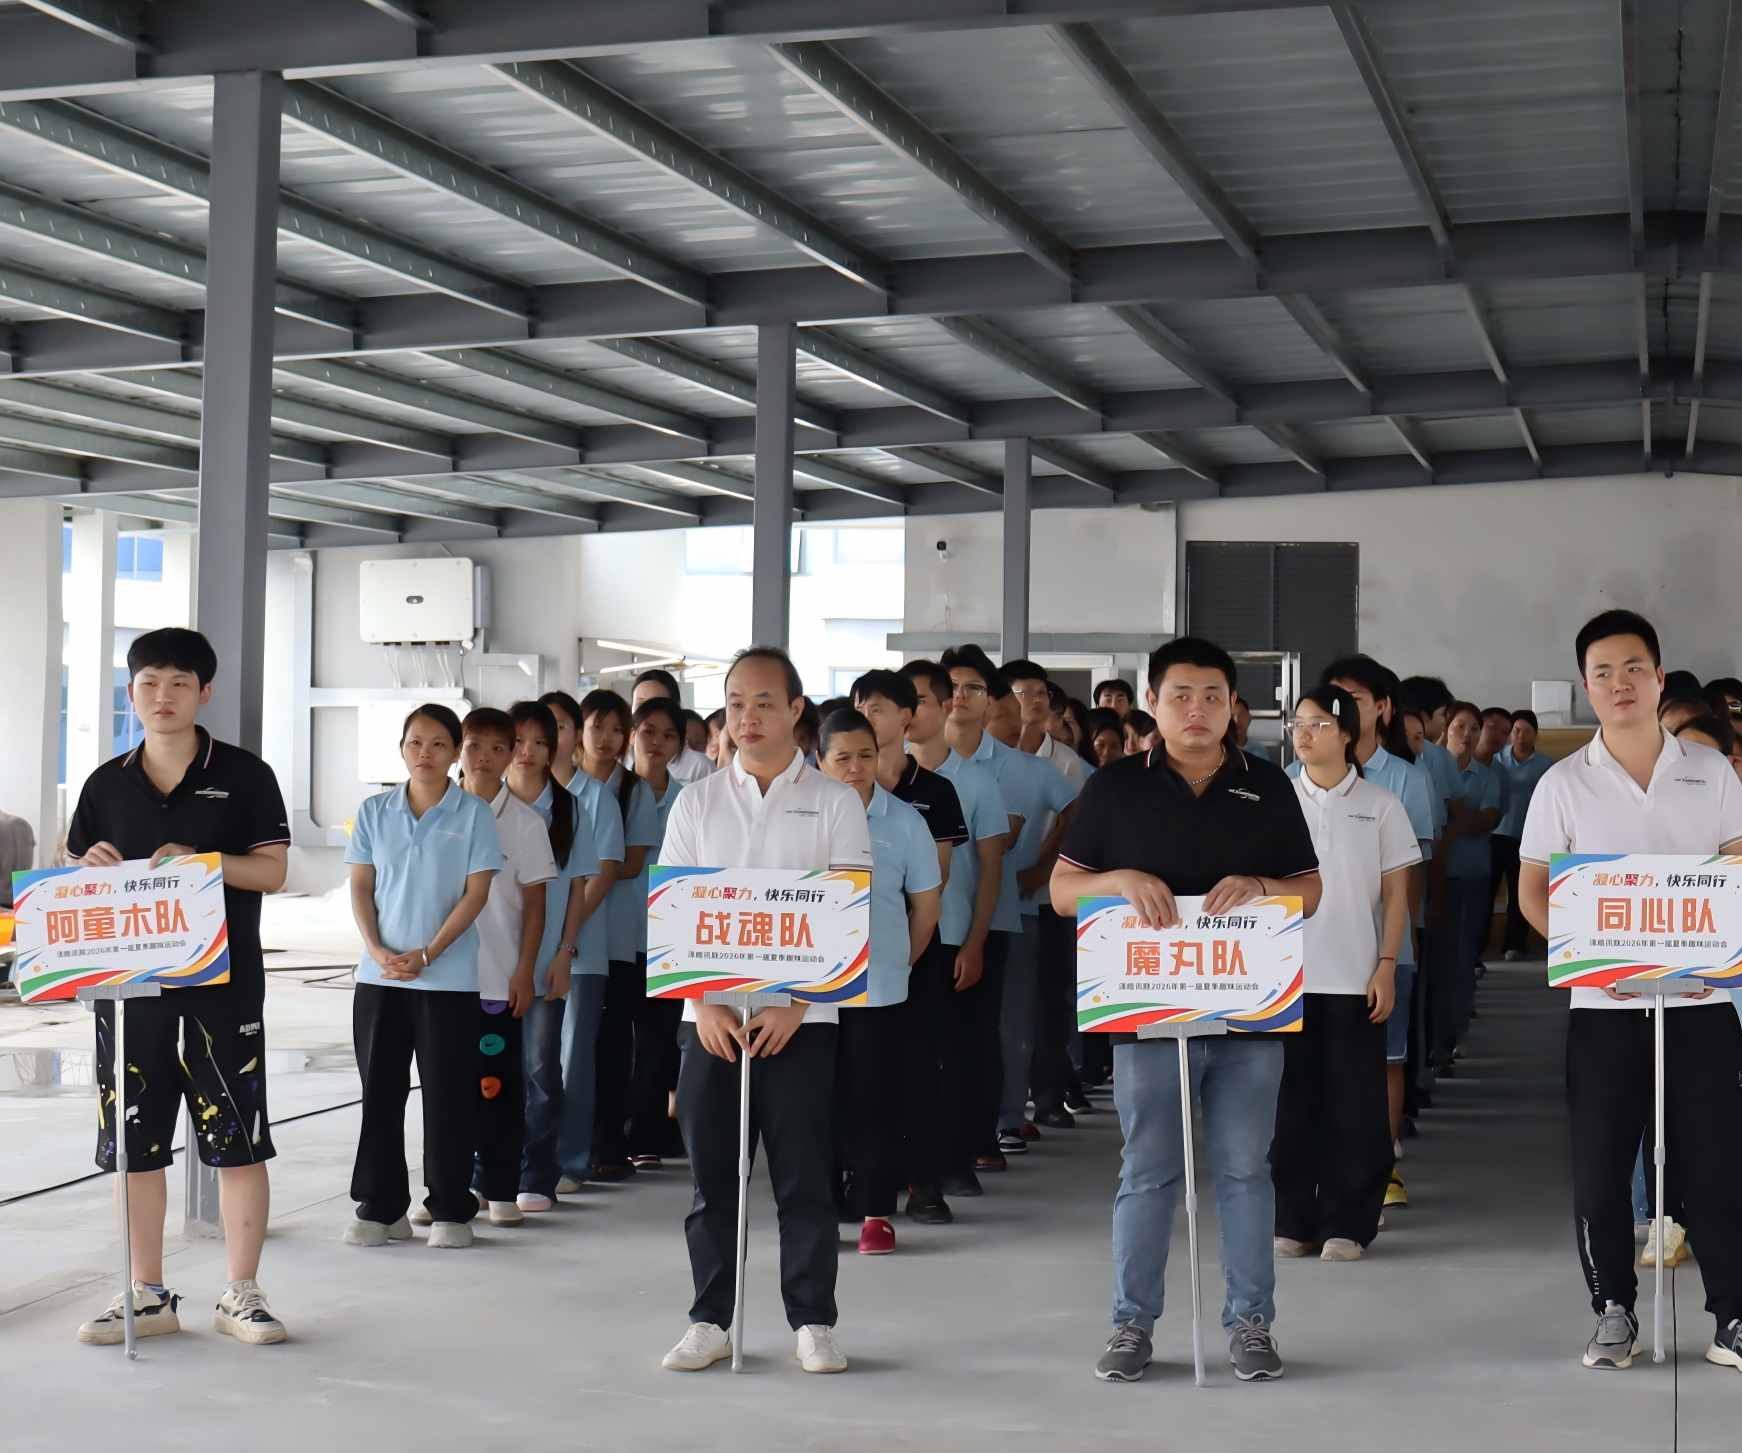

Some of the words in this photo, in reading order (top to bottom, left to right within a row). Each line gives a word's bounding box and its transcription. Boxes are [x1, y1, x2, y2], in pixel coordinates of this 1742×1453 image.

[692, 887, 825, 902] 凝心聚力，快乐同行
[1593, 873, 1727, 887] 凝心聚力，快乐同行
[47, 899, 189, 945] 阿童木队
[696, 911, 814, 947] 战魂队
[1598, 897, 1716, 933] 同心队
[1125, 940, 1247, 975] 魔丸队
